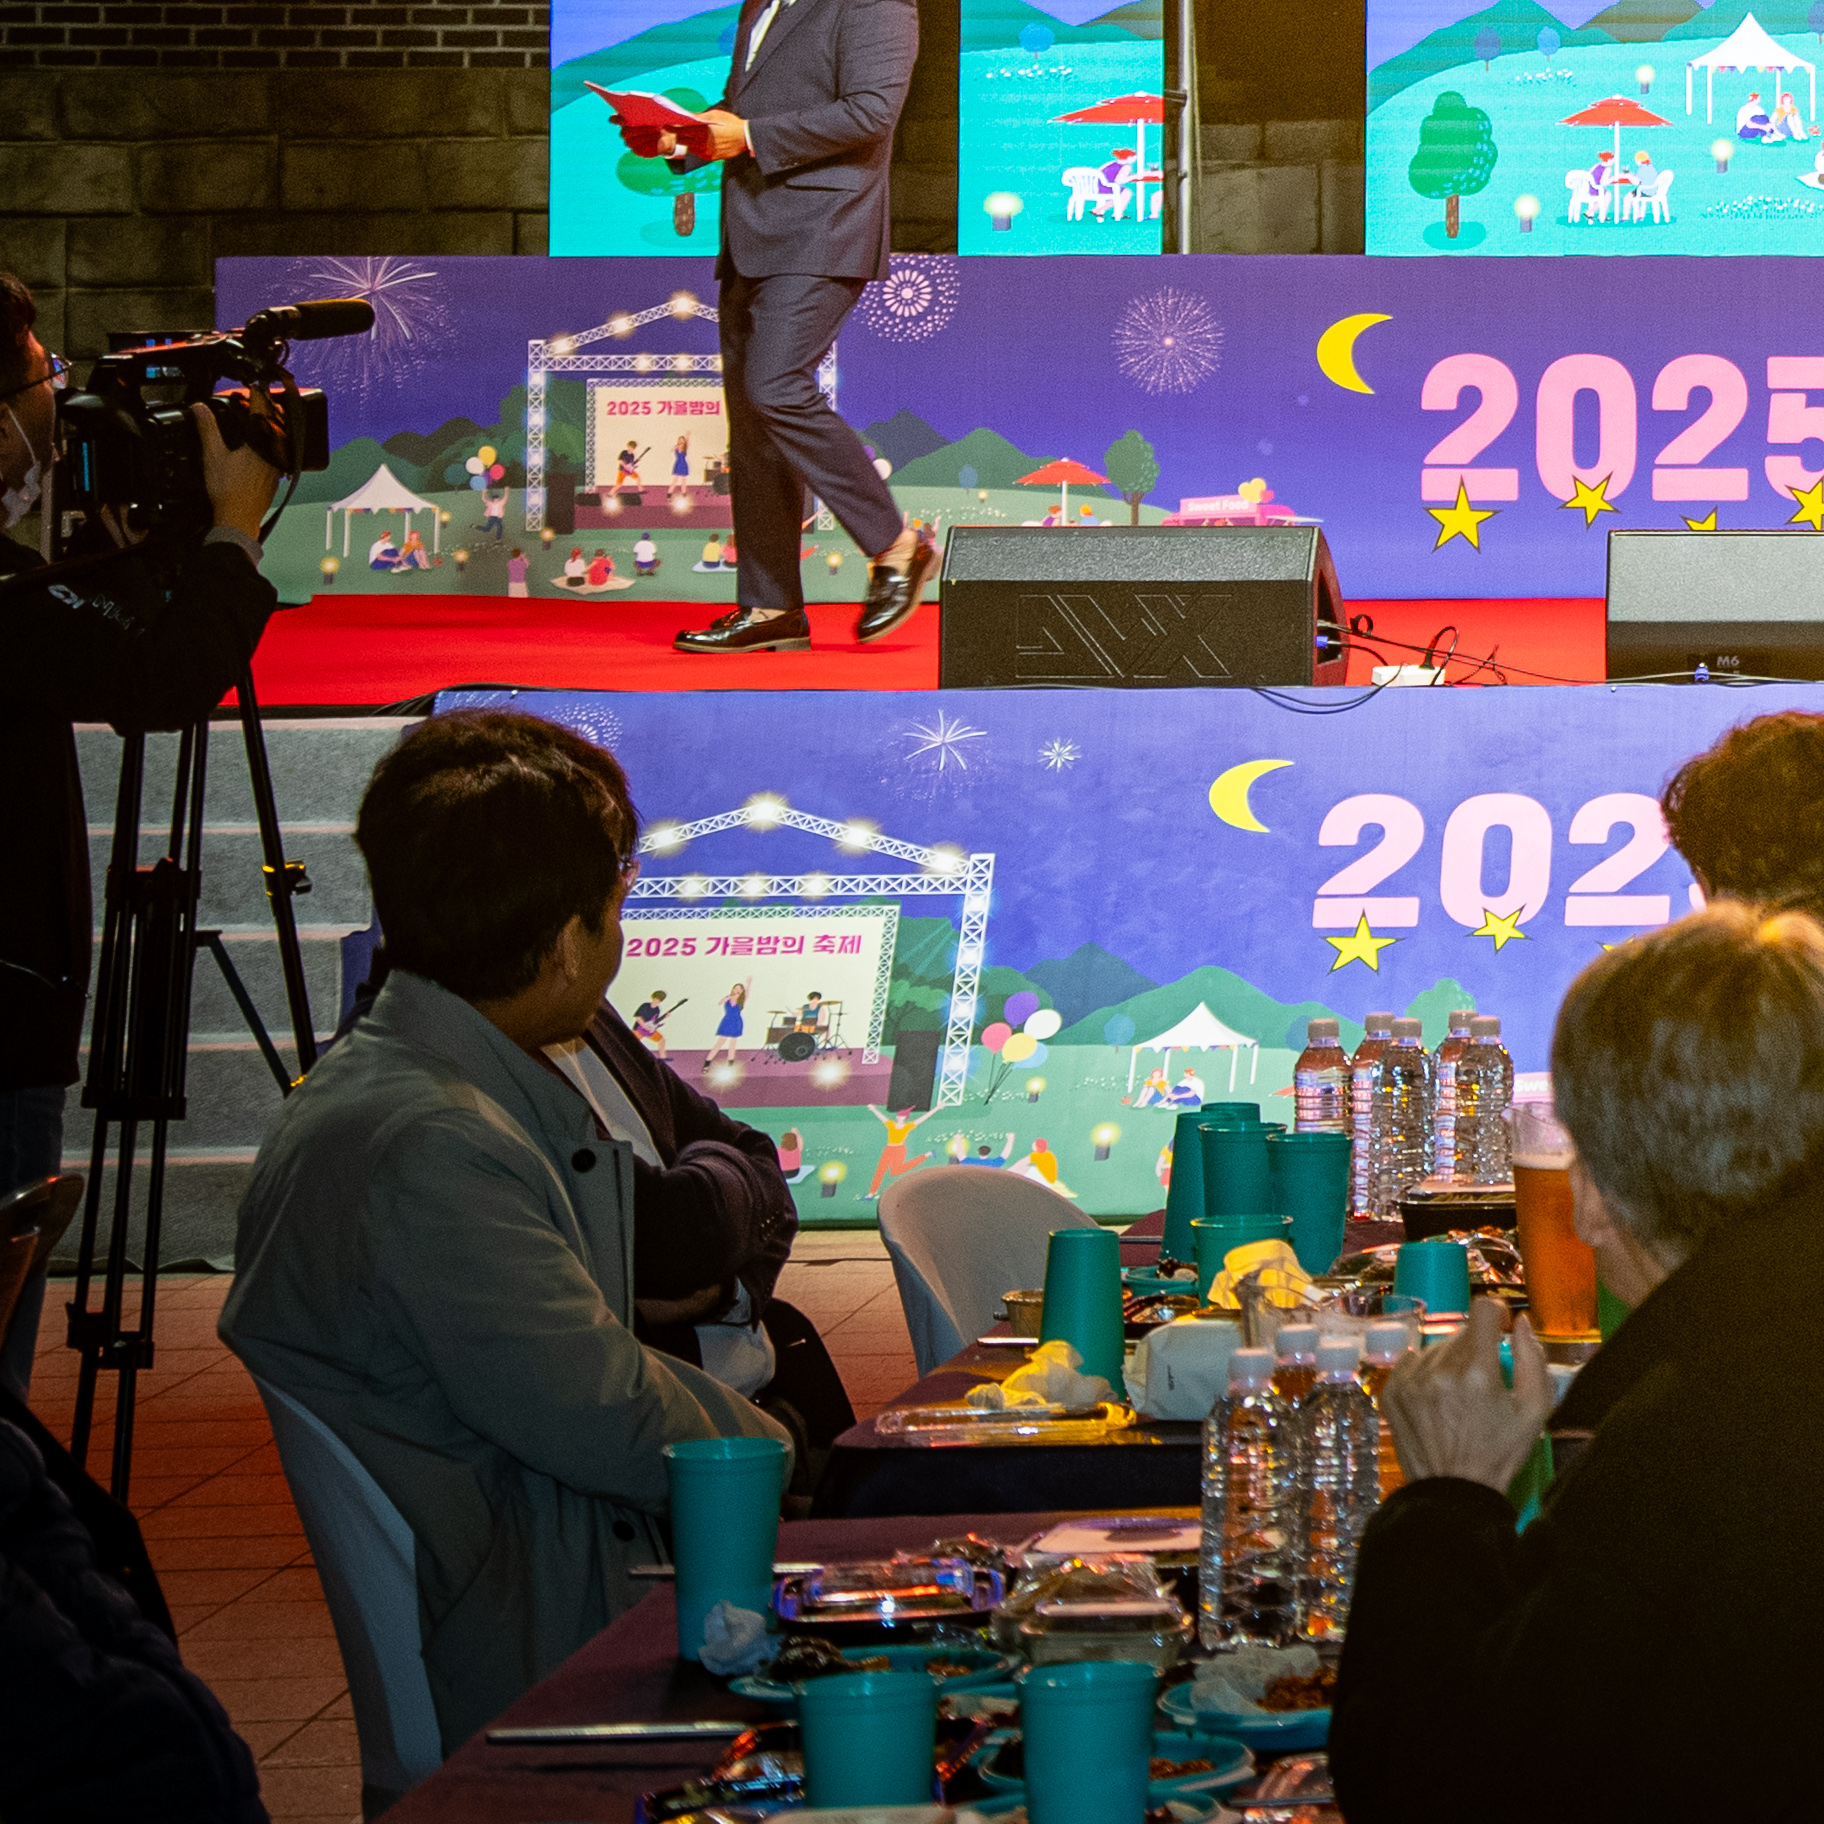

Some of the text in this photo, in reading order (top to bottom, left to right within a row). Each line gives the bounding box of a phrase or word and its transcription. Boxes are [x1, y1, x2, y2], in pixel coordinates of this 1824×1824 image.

[607, 400, 720, 415] 2025 가을밤의
[1187, 499, 1249, 512] Sweet Food
[1312, 793, 1706, 928] 202
[626, 934, 862, 957] 2025 가을밤의 축제
